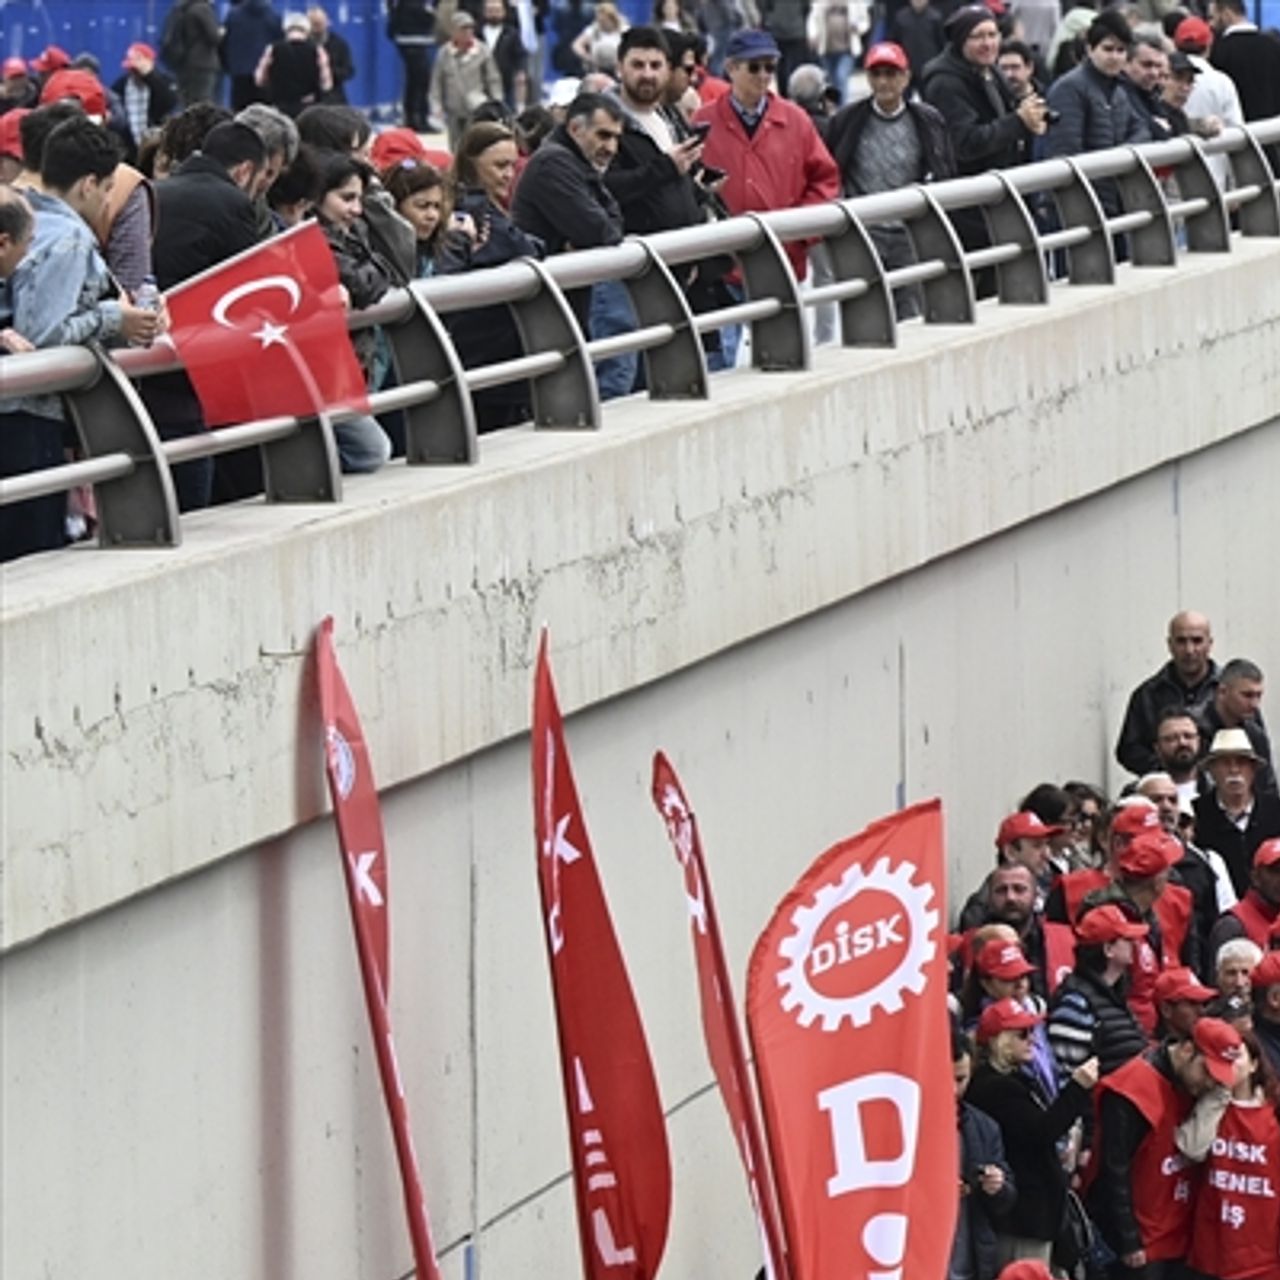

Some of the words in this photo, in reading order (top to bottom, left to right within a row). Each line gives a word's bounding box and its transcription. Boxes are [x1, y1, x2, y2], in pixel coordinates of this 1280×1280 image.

[809, 912, 904, 977] DİSK
[1212, 1137, 1268, 1165] DİSK
[1220, 1200, 1245, 1228] İŞ
